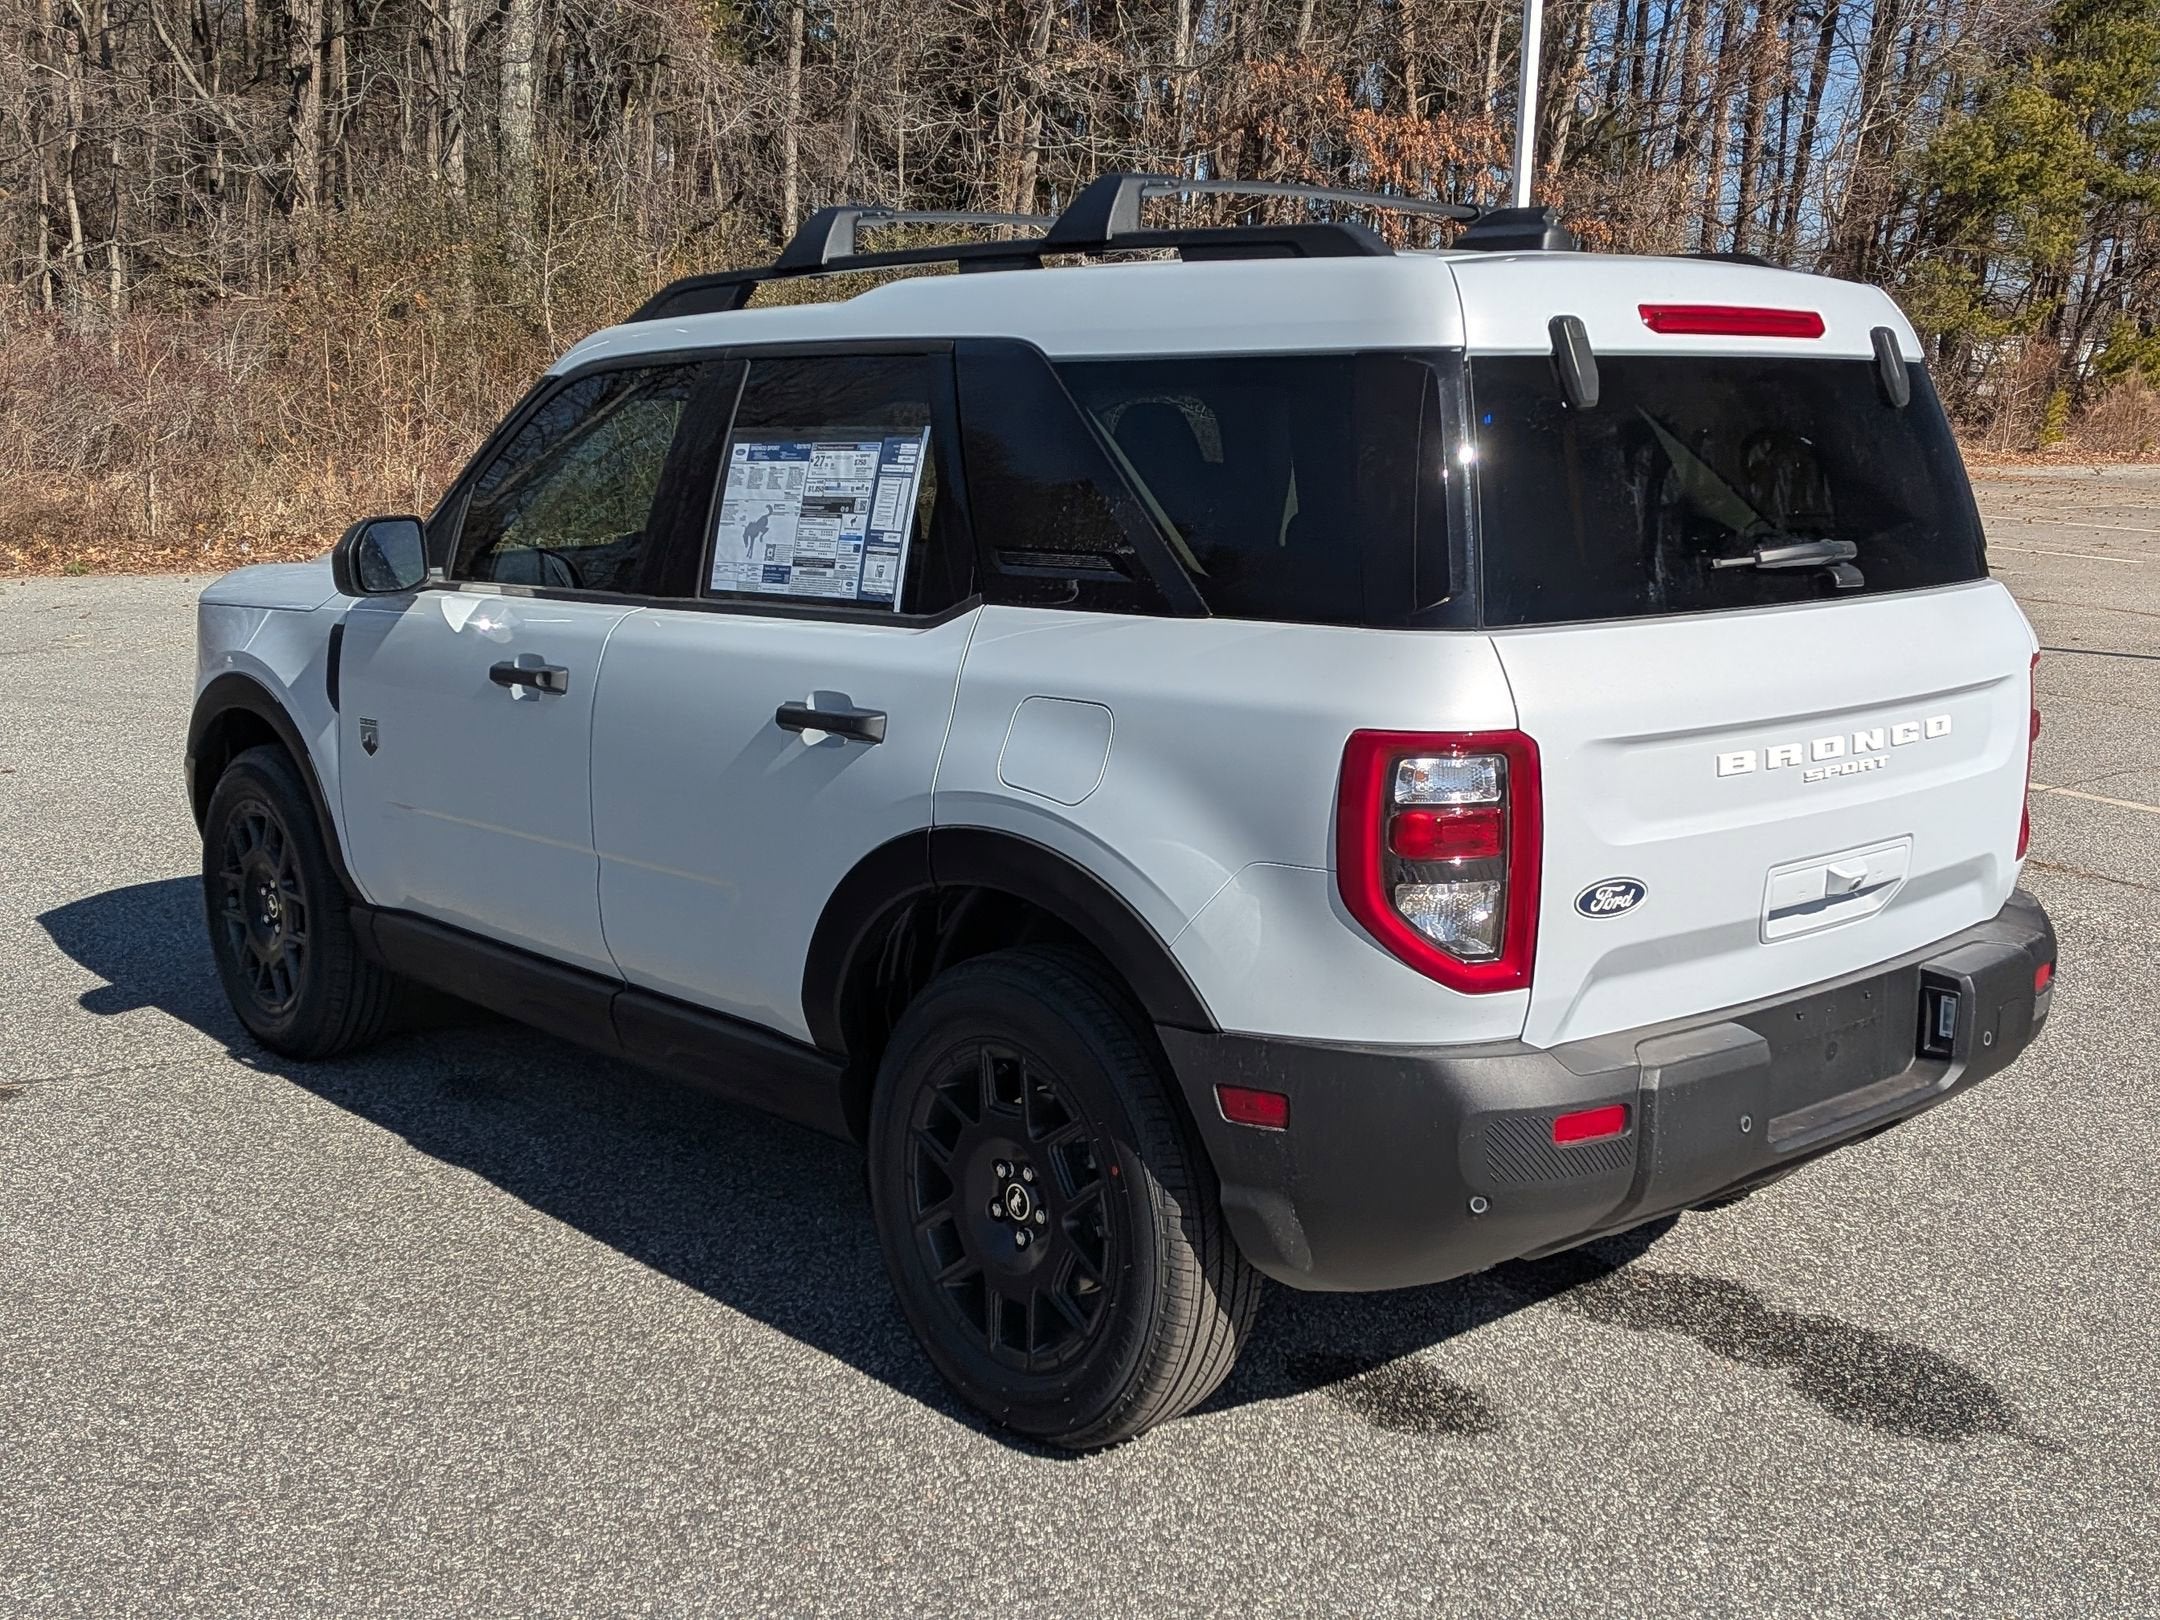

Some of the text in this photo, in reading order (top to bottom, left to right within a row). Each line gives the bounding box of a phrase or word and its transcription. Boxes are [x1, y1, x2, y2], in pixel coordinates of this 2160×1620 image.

[813, 455, 825, 467] 27
[1716, 714, 1952, 778] BRONCO
[1803, 754, 1891, 783] SPORT
[1590, 885, 1636, 912] Ford
